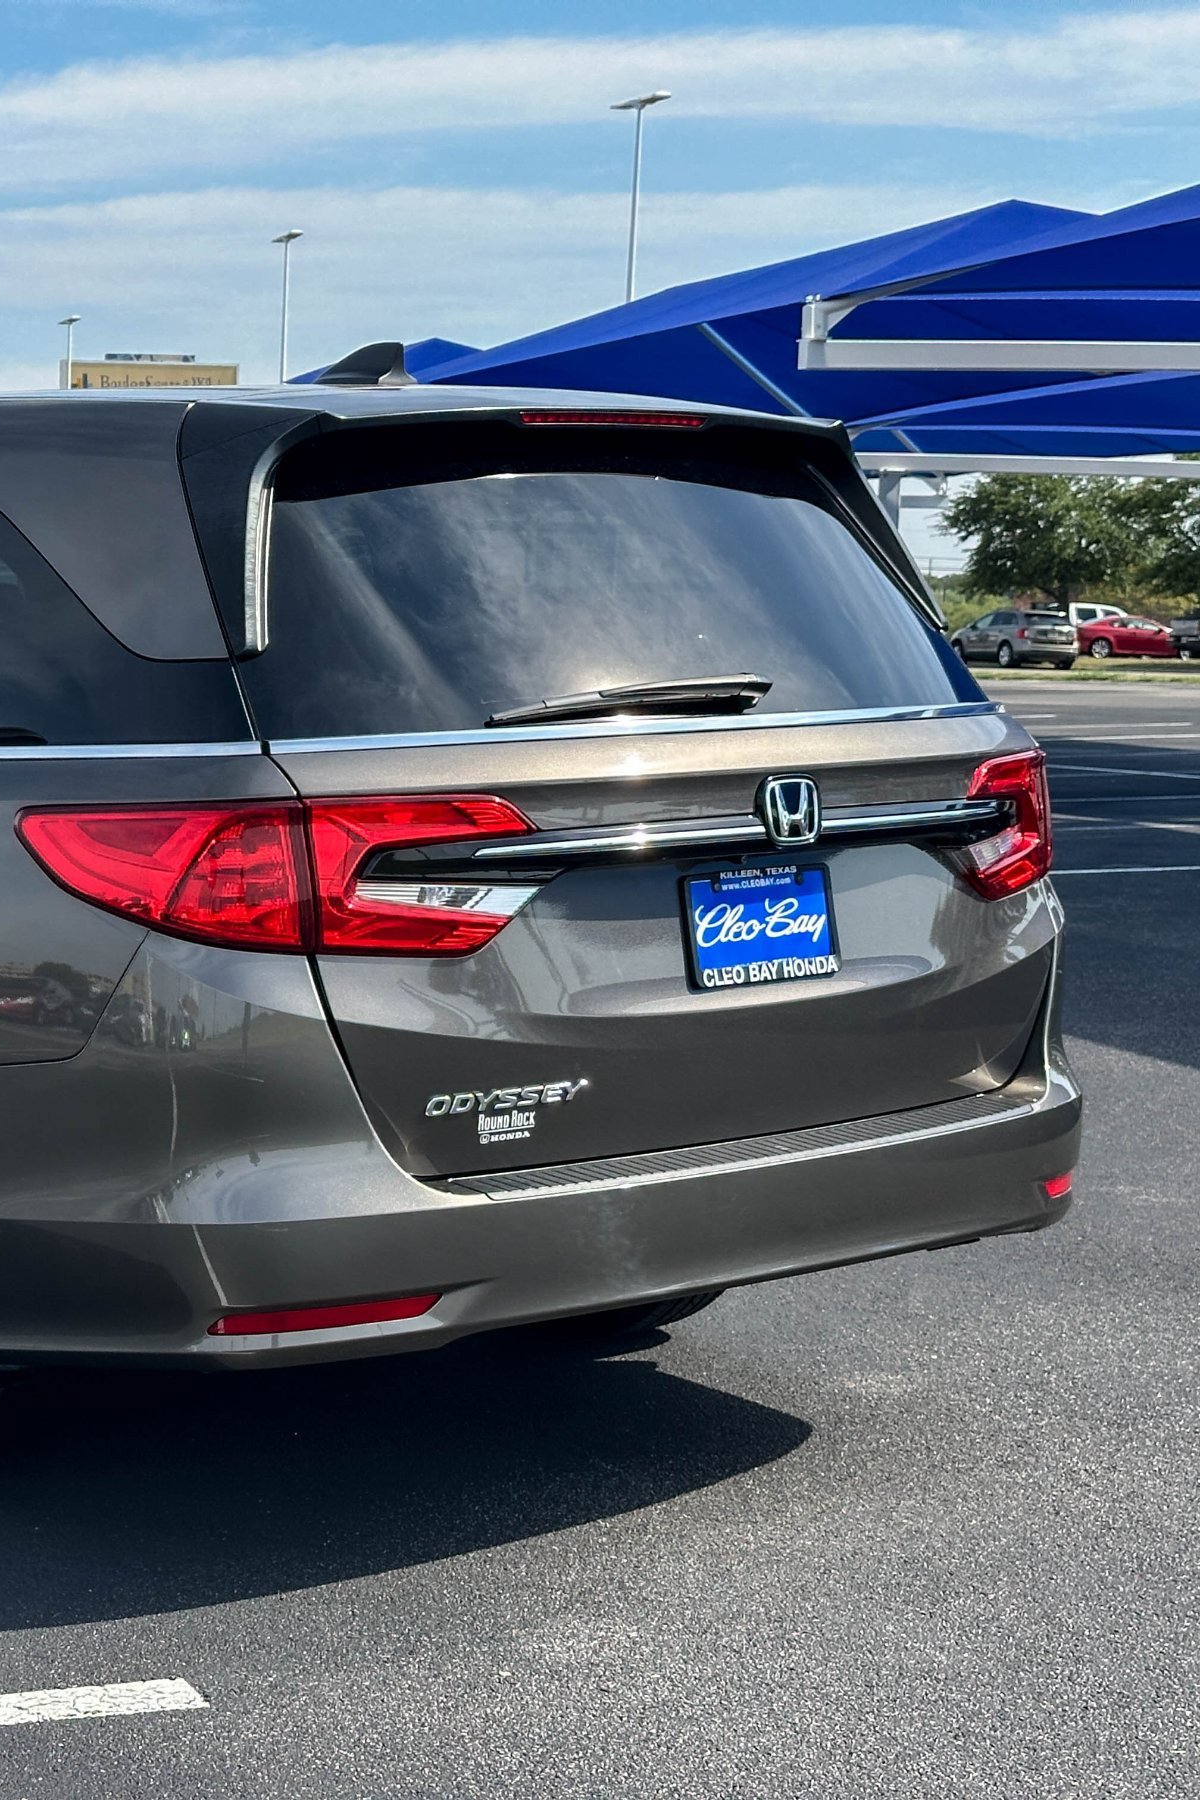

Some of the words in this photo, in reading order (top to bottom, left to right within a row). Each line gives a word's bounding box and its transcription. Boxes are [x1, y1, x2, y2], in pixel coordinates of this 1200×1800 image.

[719, 868, 763, 880] KILLEEN,
[765, 865, 797, 875] TEXAS
[721, 876, 791, 891] www.CLEOBAY.com
[695, 903, 765, 948] Cleo
[764, 897, 827, 943] Bay
[702, 966, 745, 988] CLEO
[749, 960, 779, 982] BAY
[783, 955, 839, 979] HONDA
[425, 1078, 589, 1117] ODYSSEY
[490, 1131, 531, 1142] HONDA
